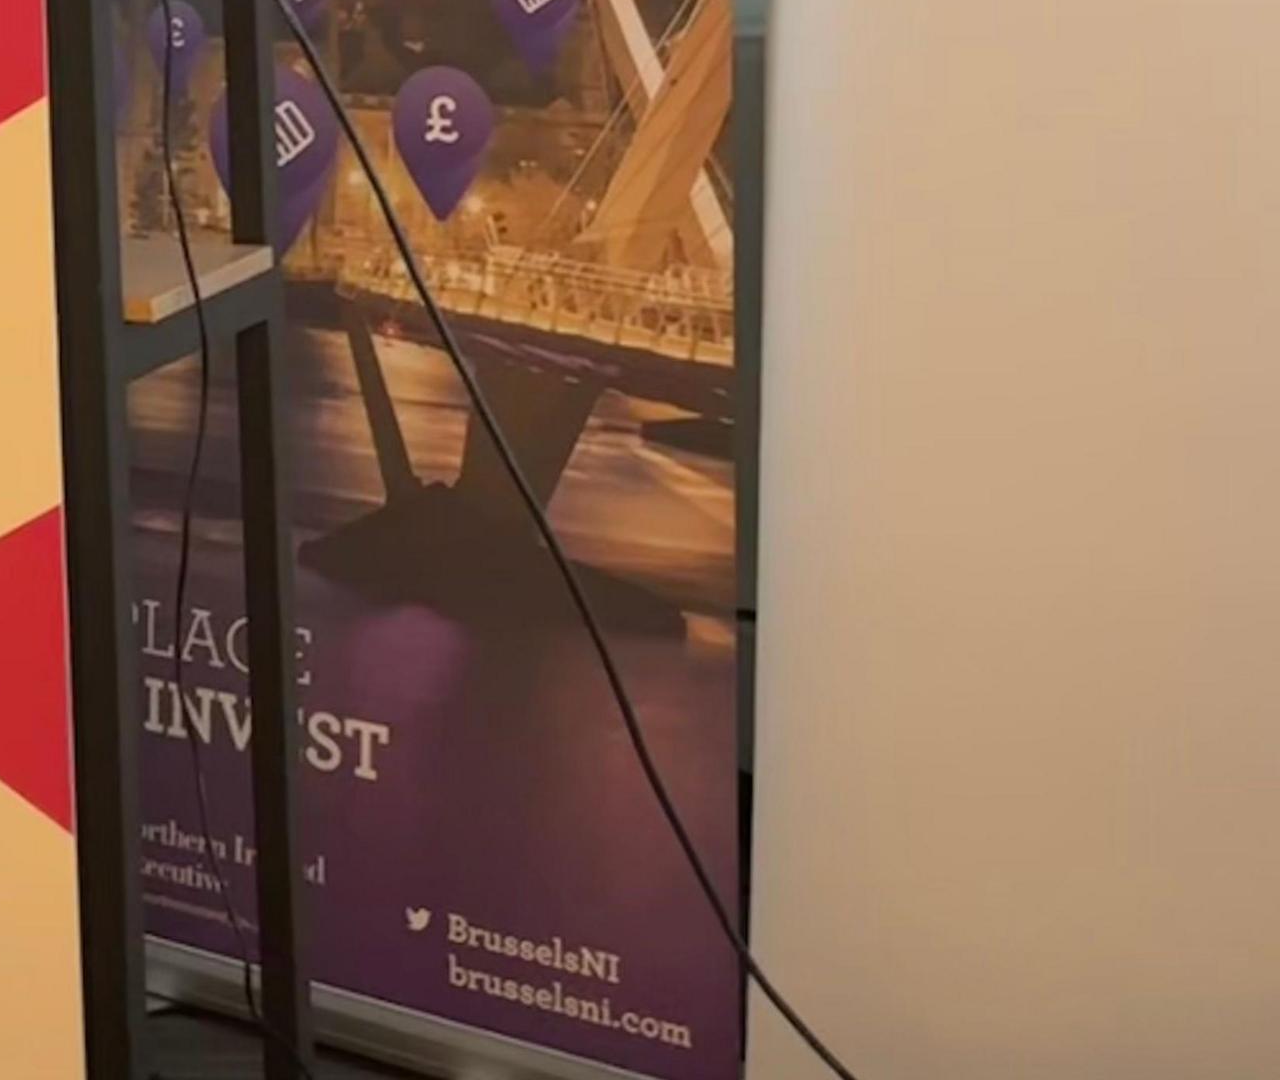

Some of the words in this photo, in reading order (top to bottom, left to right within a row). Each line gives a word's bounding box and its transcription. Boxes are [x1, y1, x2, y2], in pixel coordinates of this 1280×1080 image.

[144, 676, 390, 781] INVST
[447, 912, 621, 984] BrusselsNI
[447, 953, 693, 1048] brusselsni.com
